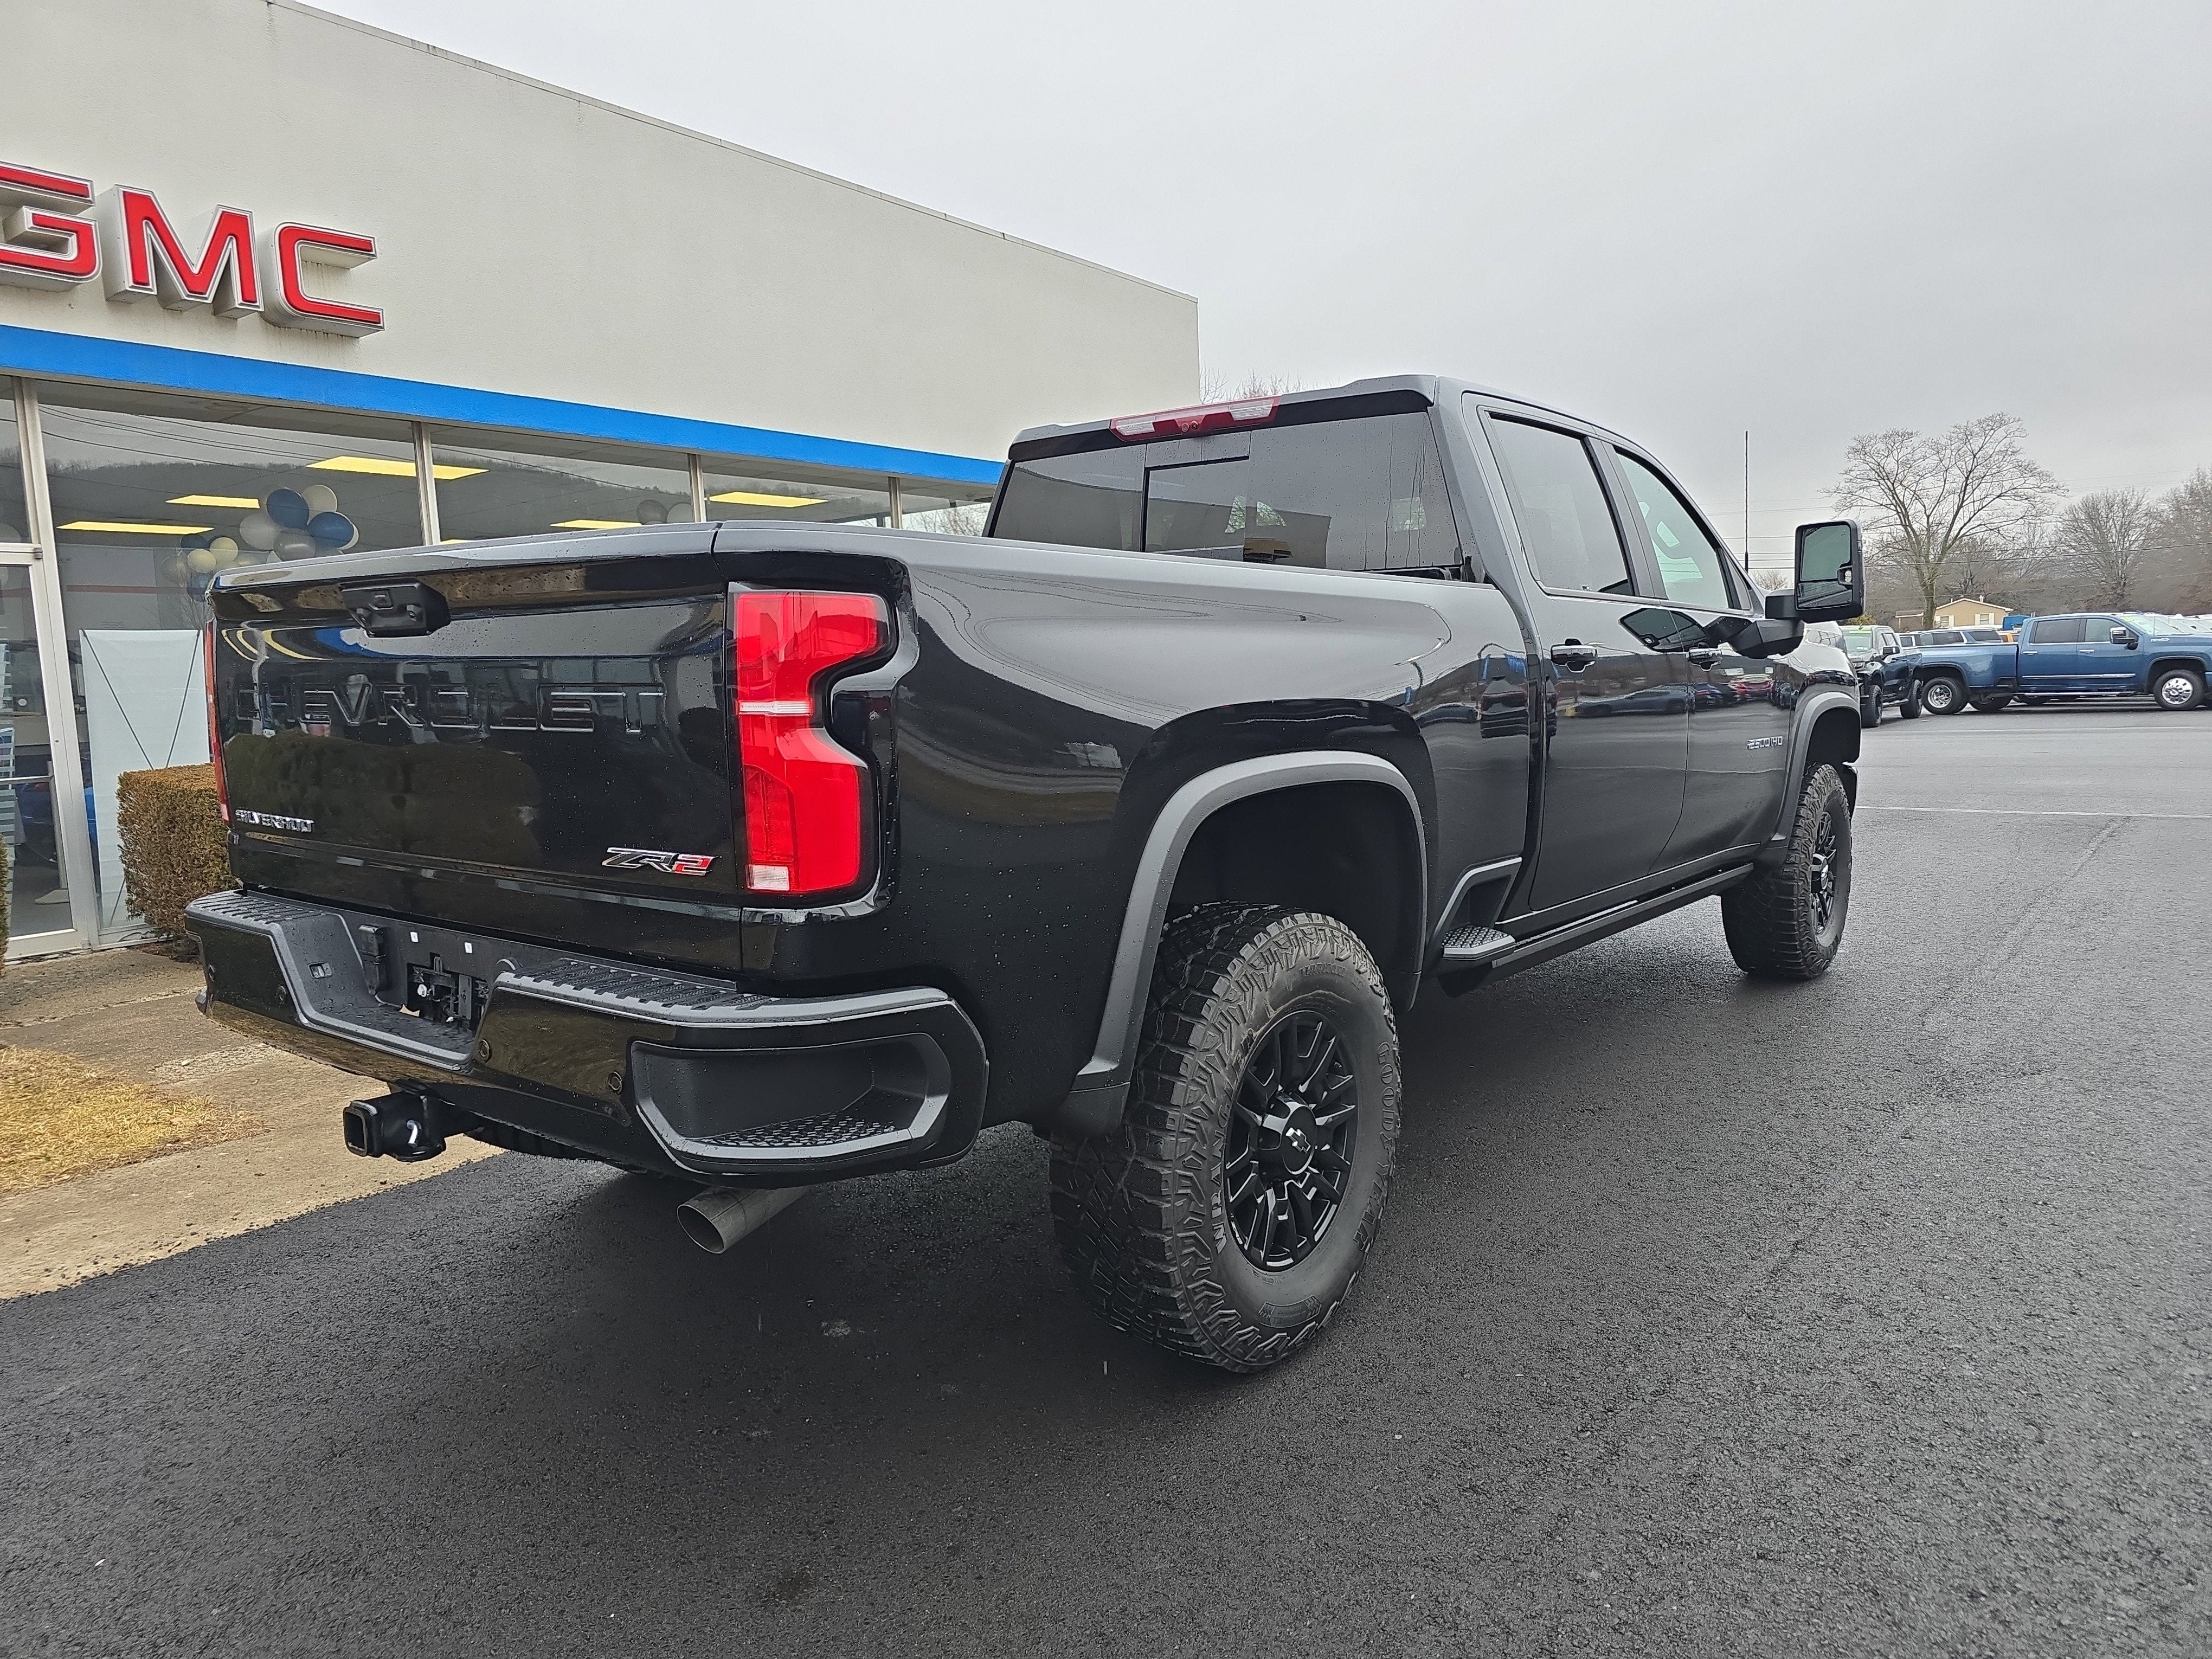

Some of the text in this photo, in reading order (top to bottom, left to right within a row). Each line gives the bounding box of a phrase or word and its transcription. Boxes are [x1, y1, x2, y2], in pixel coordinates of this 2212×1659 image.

[0, 161, 385, 332] GMC
[231, 681, 666, 735] CHEVROLET
[1747, 737, 1770, 750] 2500
[601, 846, 715, 876] ZR2
